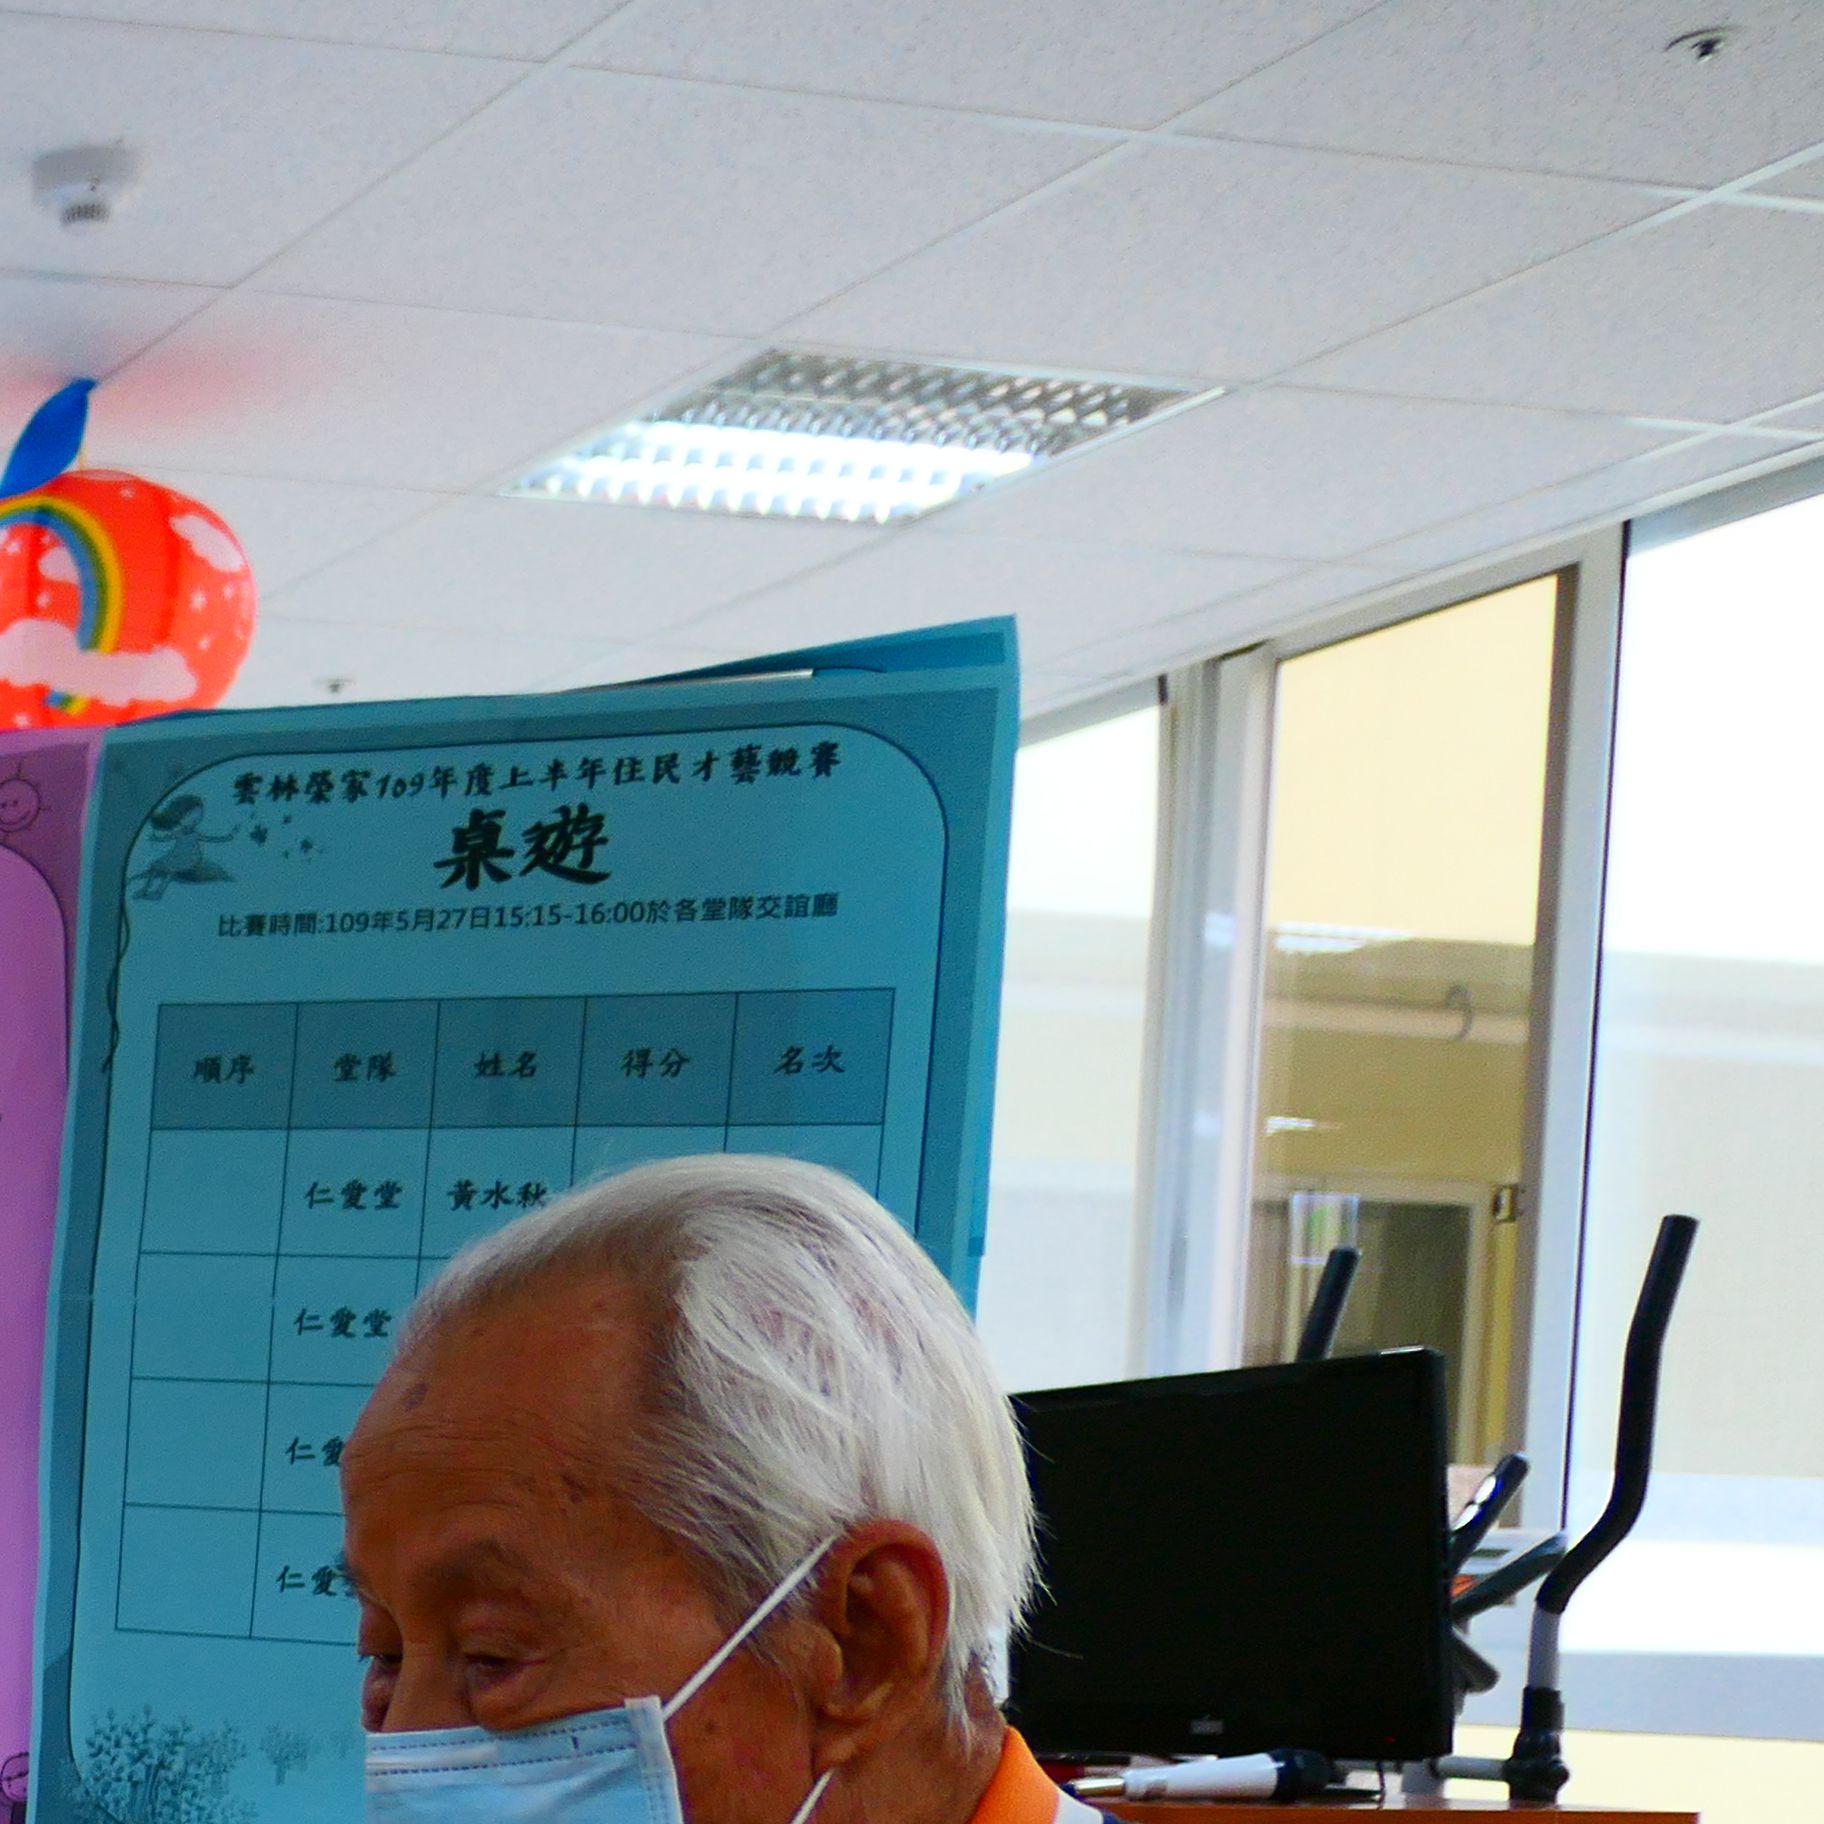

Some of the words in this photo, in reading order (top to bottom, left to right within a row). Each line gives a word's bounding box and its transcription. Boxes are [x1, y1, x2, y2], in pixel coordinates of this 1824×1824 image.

[433, 801, 611, 890] 桌遊
[192, 1052, 254, 1085] 順序
[331, 1050, 397, 1083] 堂隊
[473, 1049, 538, 1079] 姓名
[619, 1046, 690, 1077] 得分
[772, 1044, 846, 1075] 名次
[304, 1179, 403, 1212] 仁愛堂
[293, 1305, 393, 1339] 仁愛堂
